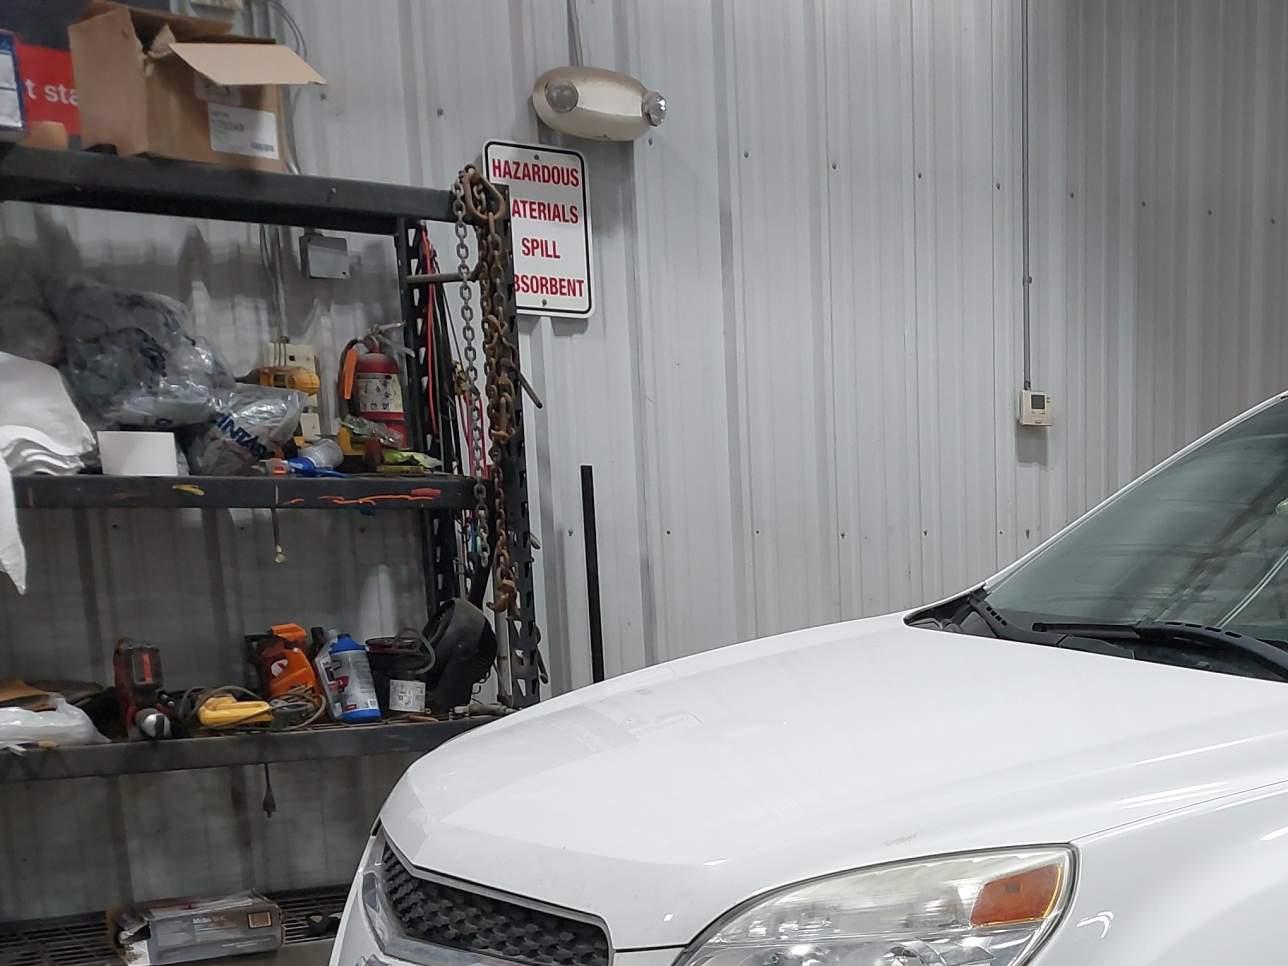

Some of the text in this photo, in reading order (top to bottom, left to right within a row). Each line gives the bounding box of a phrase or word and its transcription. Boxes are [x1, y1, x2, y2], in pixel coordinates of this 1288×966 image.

[491, 158, 580, 188] HAZARDOUS
[511, 198, 579, 225] ATERIALS
[521, 237, 561, 260] SPILL
[513, 273, 585, 298] BSORBENT
